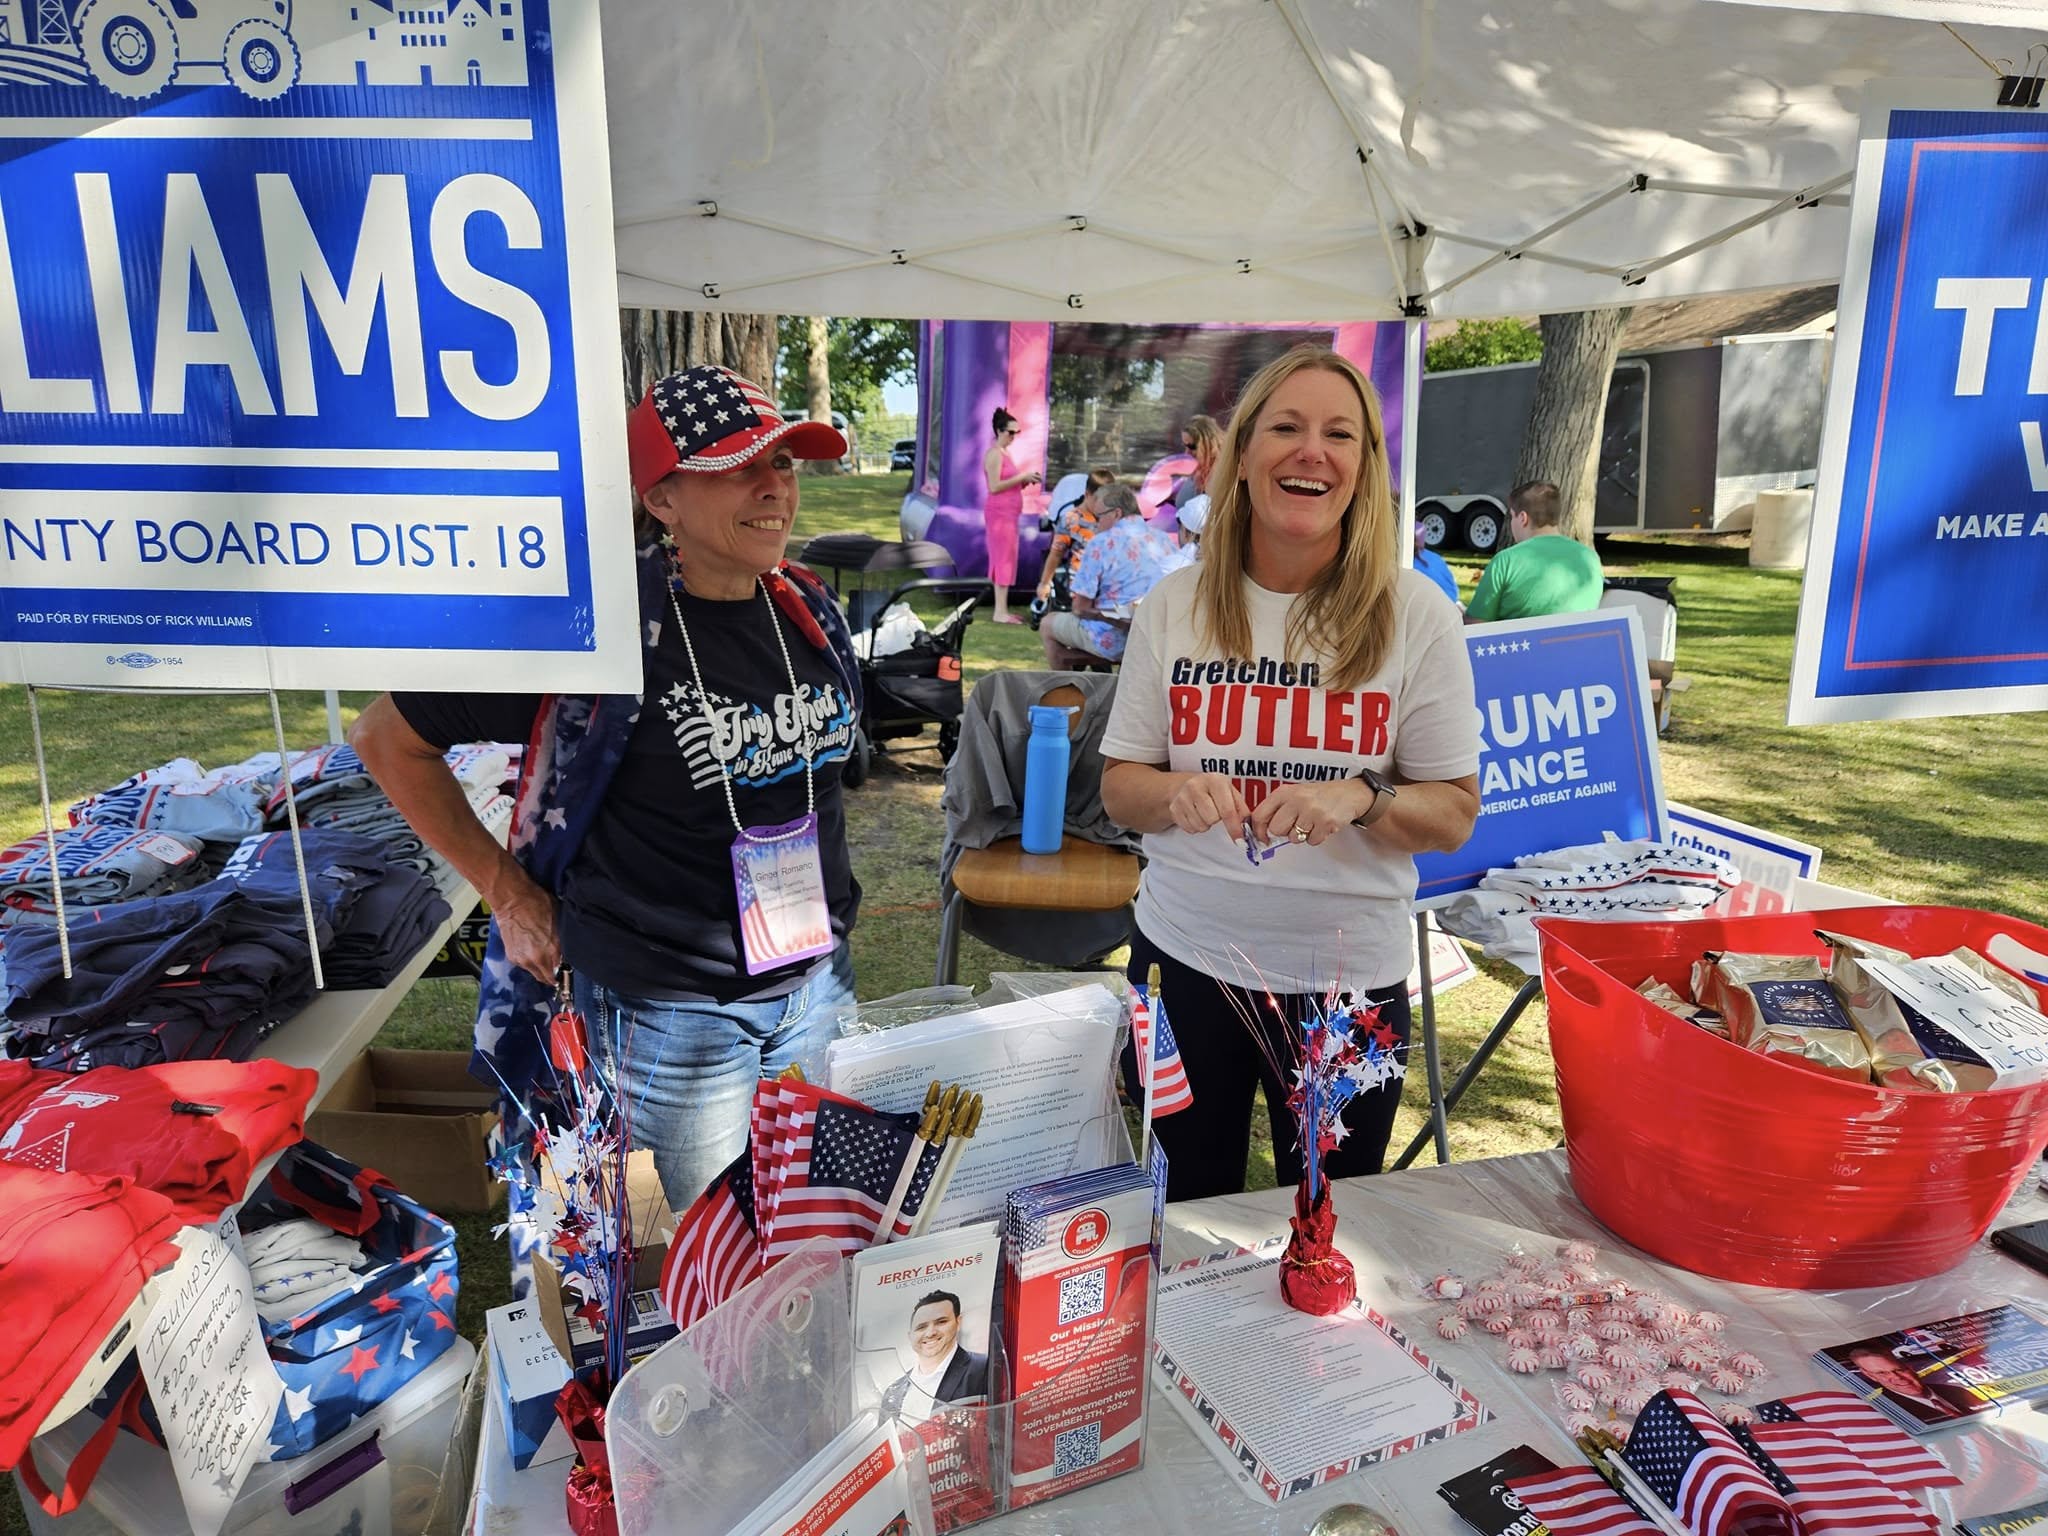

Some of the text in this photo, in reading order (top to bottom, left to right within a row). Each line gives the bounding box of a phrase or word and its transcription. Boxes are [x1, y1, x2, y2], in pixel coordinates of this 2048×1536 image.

[0, 172, 552, 421] LIAMS
[1936, 513, 2024, 539] MAKE
[135, 519, 330, 568] BOARD
[352, 523, 476, 570] DIST.
[498, 525, 547, 570] 18
[17, 611, 253, 628] PAID FOR BY FRIENDS OF RICK WILLIAMS
[162, 657, 183, 665] 1954
[1171, 656, 1320, 687] Gretchen
[709, 683, 840, 760] Try That
[1169, 684, 1391, 756] BUTLER
[733, 723, 850, 777] in Kane County
[1201, 757, 1349, 781] FOR KANE COUNTY
[1480, 746, 1589, 796] ANCE
[1531, 789, 1571, 807] GREAT
[1574, 780, 1617, 799] AGAIN!
[781, 862, 813, 875] Romano
[1763, 984, 1835, 1008] VICTORY GROUNDS
[1078, 1213, 1096, 1222] KANE
[1071, 1242, 1098, 1255] COUNTY
[877, 1256, 974, 1286] JERRY EVANS
[911, 1270, 957, 1286] CONGRESS
[1054, 1256, 1115, 1280] SCAN TO VOLUNTEER
[1184, 1272, 1222, 1288] WARRIOR
[145, 1214, 235, 1363] TRUMP SHIRTS
[186, 1284, 231, 1358] Donation
[1048, 1315, 1115, 1342] Our Mission
[1022, 1352, 1036, 1361] The
[1036, 1346, 1055, 1357] Kane
[1054, 1337, 1081, 1350] County
[1080, 1325, 1122, 1342] Repblican
[1028, 1349, 1065, 1365] advocates
[1065, 1344, 1076, 1353] for
[1076, 1340, 1088, 1348] the
[1038, 1338, 1122, 1367] limited govement and
[1031, 1379, 1044, 1387] We
[1085, 1362, 1100, 1371] this
[1099, 1353, 1128, 1367] through
[1045, 1346, 1115, 1371] conservive values.
[1057, 1356, 1138, 1386] training, and equipping
[1021, 1374, 1136, 1416] educate voters and win elections.
[1038, 1385, 1069, 1399] engaged
[1069, 1374, 1102, 1388] citizenry
[1101, 1368, 1117, 1378] with
[1117, 1364, 1130, 1373] the
[1050, 1392, 1063, 1400] and
[1063, 1381, 1095, 1396] support
[1095, 1374, 1118, 1385] needed
[1020, 1386, 1137, 1432] Join the Movement Now
[1026, 1398, 1129, 1439] NOVEMBER 5TH, 2024
[806, 1445, 887, 1525] OPTICS SUGGEST SHE DOES
[809, 1461, 884, 1531] FIRST AND WANTS US TO
